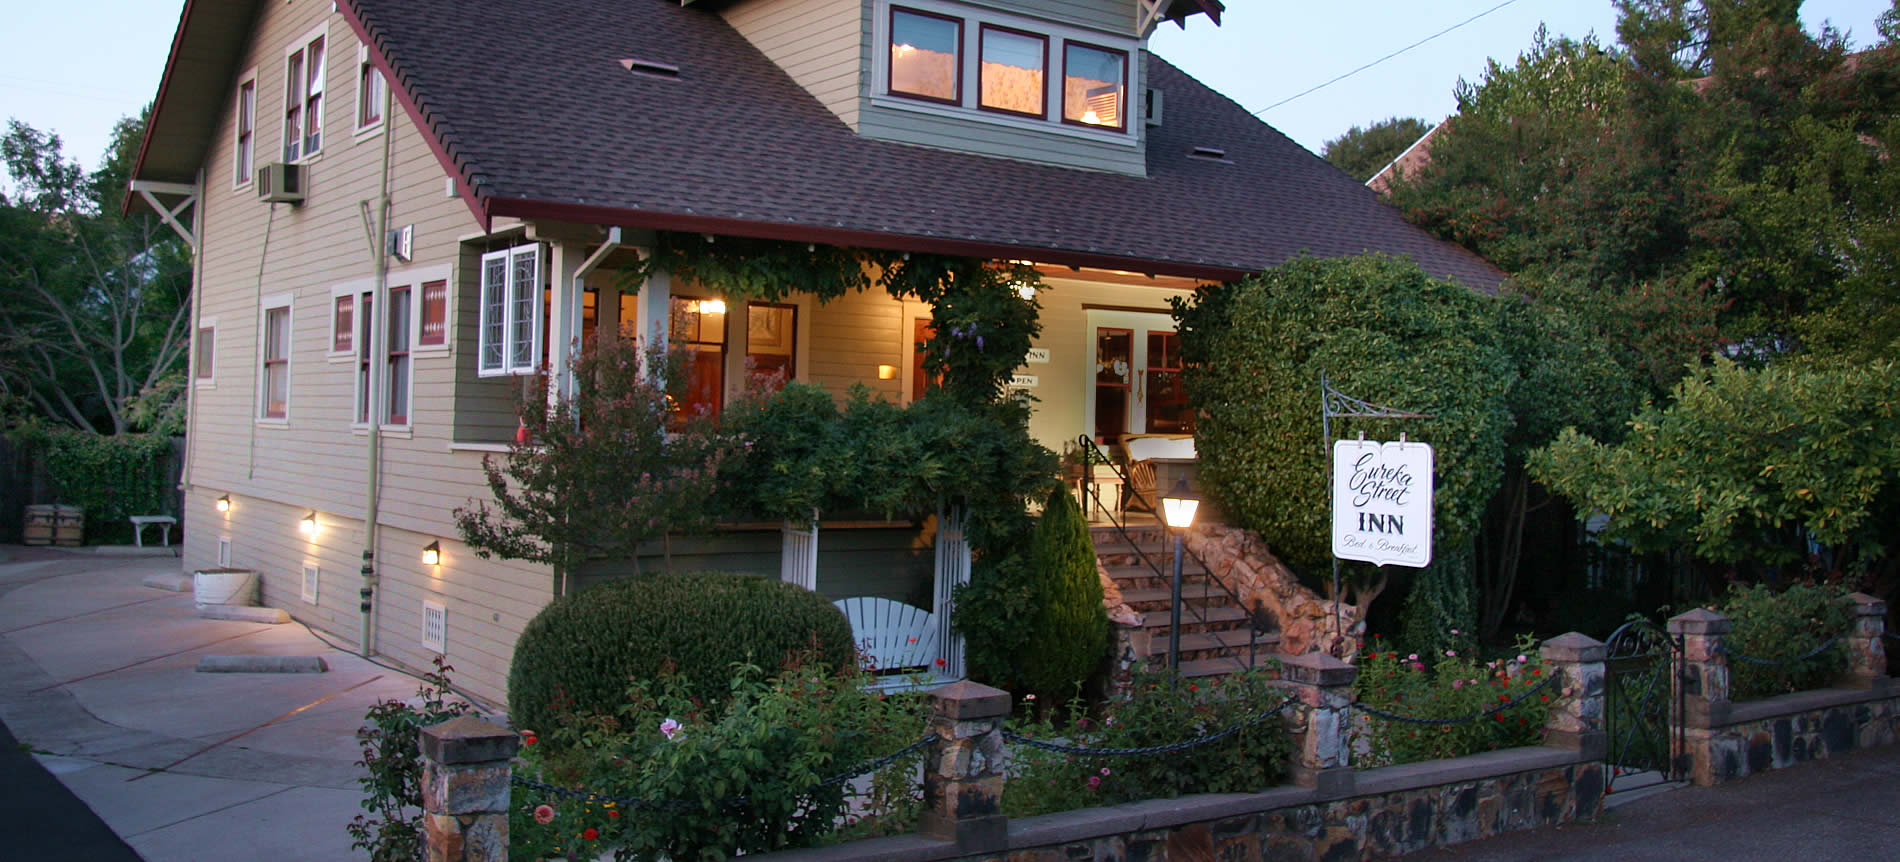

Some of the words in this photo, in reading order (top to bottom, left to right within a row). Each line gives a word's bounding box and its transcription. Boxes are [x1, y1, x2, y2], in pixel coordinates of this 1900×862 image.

[1349, 452, 1413, 490] Eureka
[1353, 480, 1411, 507] Street
[1359, 512, 1404, 535] INN
[1343, 534, 1367, 547] Bed
[1375, 538, 1418, 555] Breakfast
